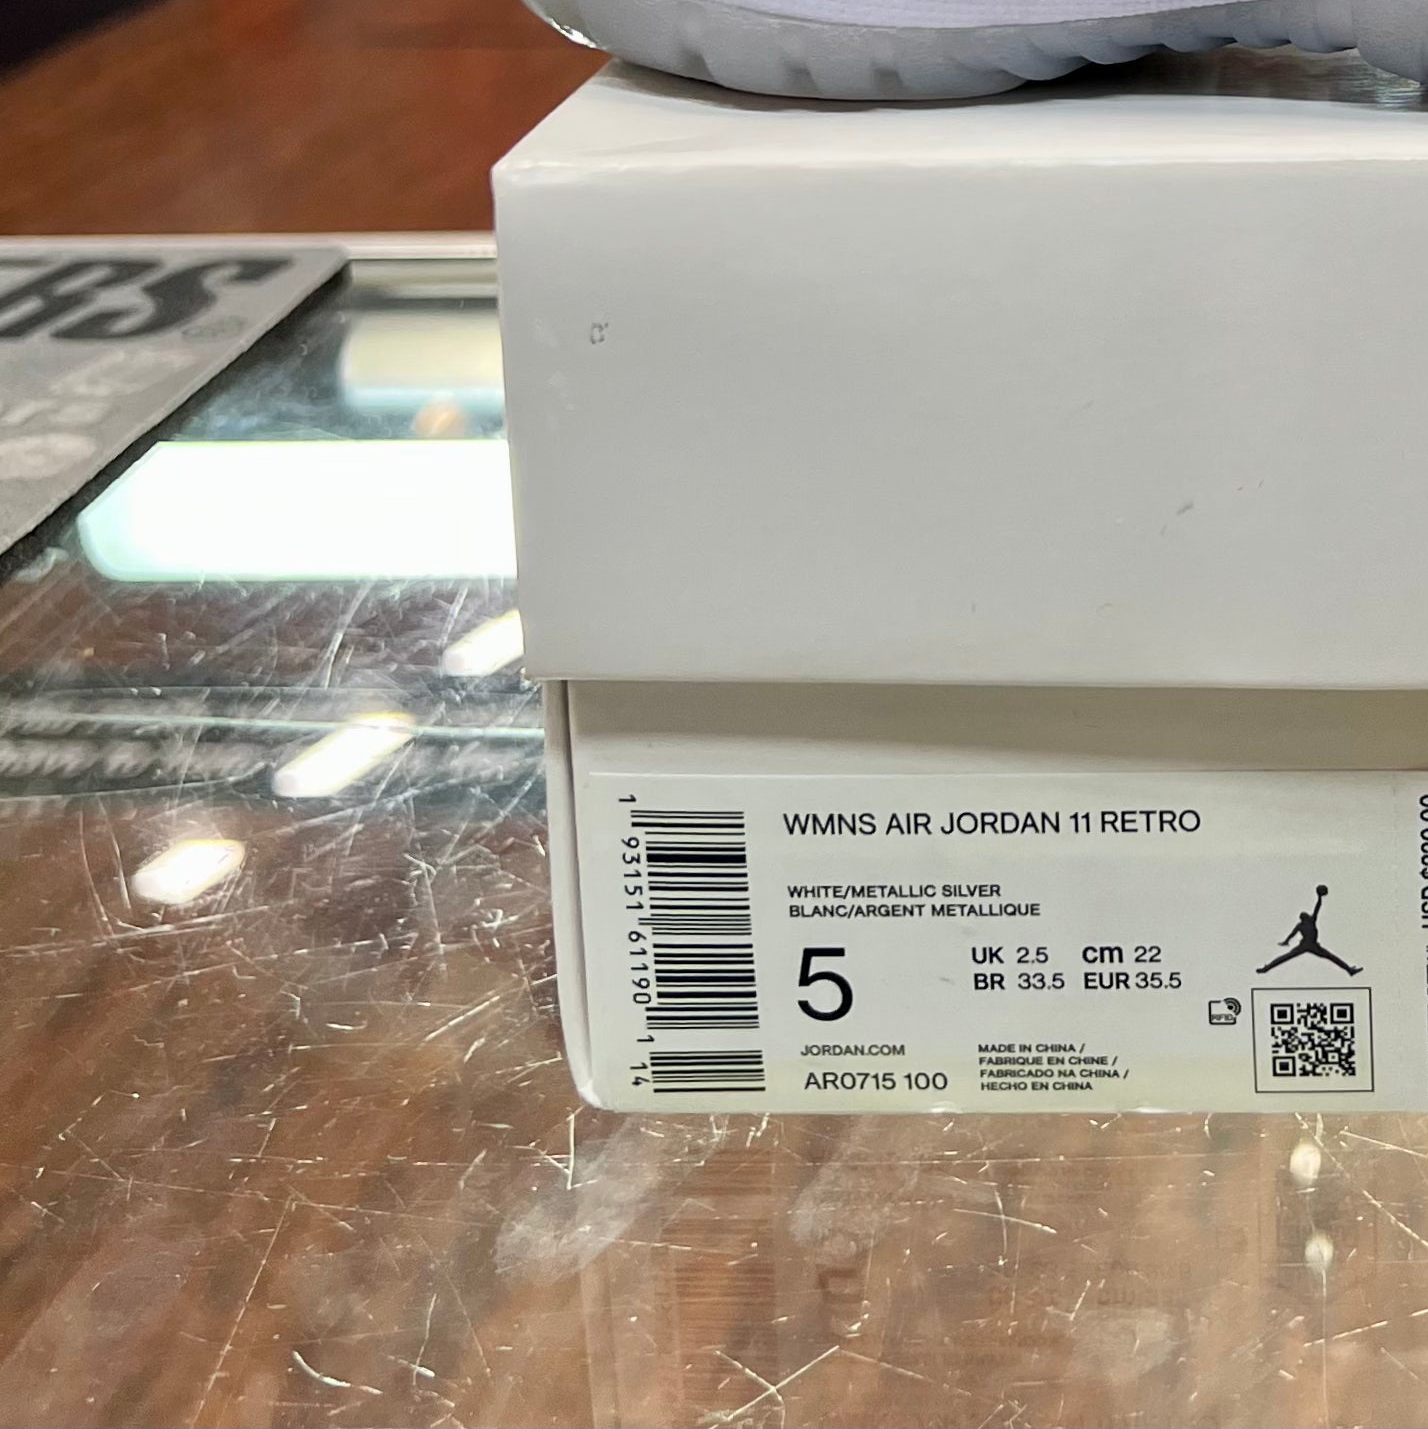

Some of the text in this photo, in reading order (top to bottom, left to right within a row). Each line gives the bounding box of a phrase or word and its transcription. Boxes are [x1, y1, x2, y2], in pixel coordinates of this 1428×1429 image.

[783, 809, 1201, 835] WMNS AIR JORDAN 11 RETRO
[787, 884, 1001, 899] WHITE/METALLIC SILVER
[789, 903, 1041, 918] BLANC/ARGENT METALLIQUE
[971, 946, 1049, 964] UK 2.5
[1082, 945, 1162, 964] cm 22
[798, 947, 853, 1022] 5
[974, 972, 1065, 990] BR 33.5
[1084, 971, 1182, 990] EUR 35.5
[800, 1044, 905, 1056] JORDAN.COM
[978, 1044, 1016, 1053] MADE
[1019, 1044, 1032, 1053] IN
[1035, 1043, 1076, 1053] CHINA
[979, 1056, 1043, 1066] FABRIQUE
[1047, 1056, 1065, 1065] EN
[1068, 1056, 1108, 1065] CHINE
[804, 1072, 948, 1090] AR0715 100
[980, 1069, 1054, 1078] FABRICADO
[1058, 1069, 1076, 1078] NA
[1079, 1069, 1120, 1078] CHINA
[981, 1081, 1093, 1091] HECHO EN CHINA
